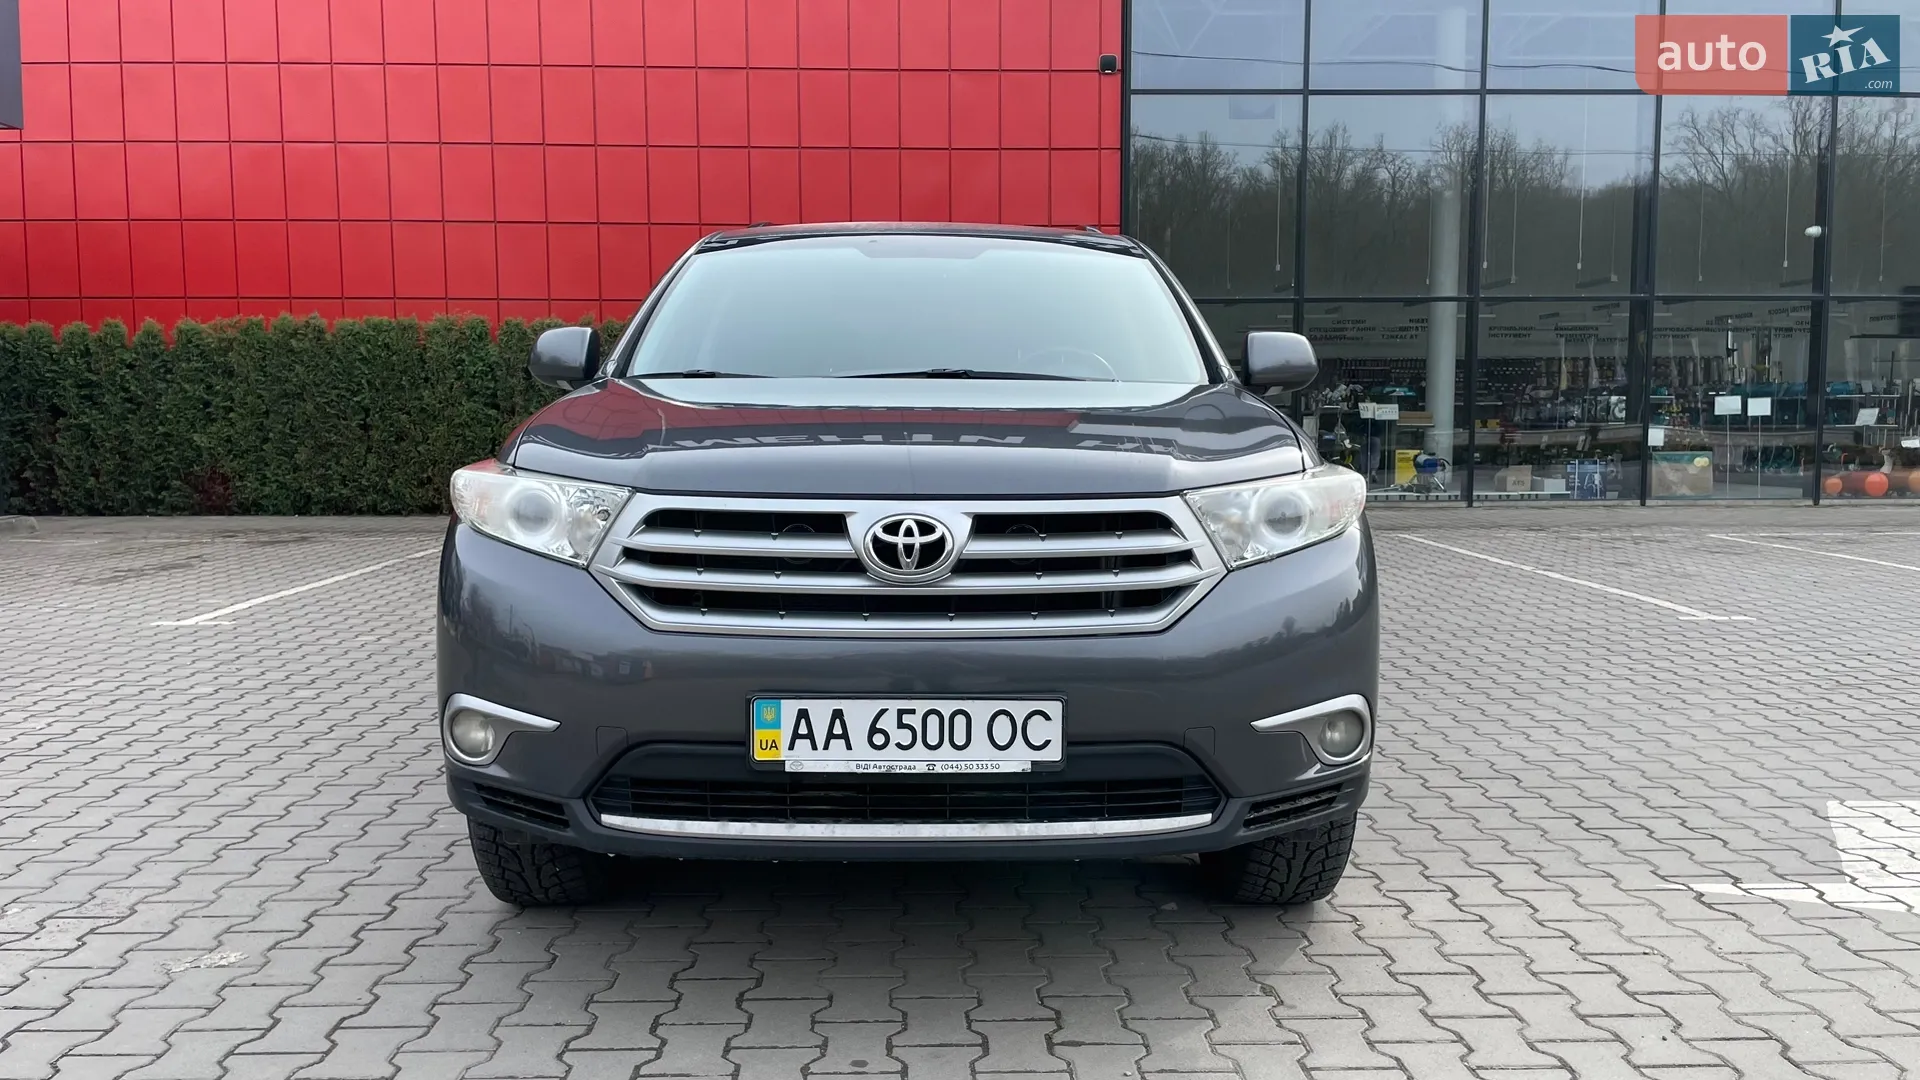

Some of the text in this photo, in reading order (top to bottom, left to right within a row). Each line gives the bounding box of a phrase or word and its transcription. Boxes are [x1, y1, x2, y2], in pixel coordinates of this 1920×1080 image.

[787, 708, 1053, 751] AA 6500 OC
[759, 738, 779, 751] UA
[873, 763, 917, 773] Автострада
[940, 763, 963, 771] (044)
